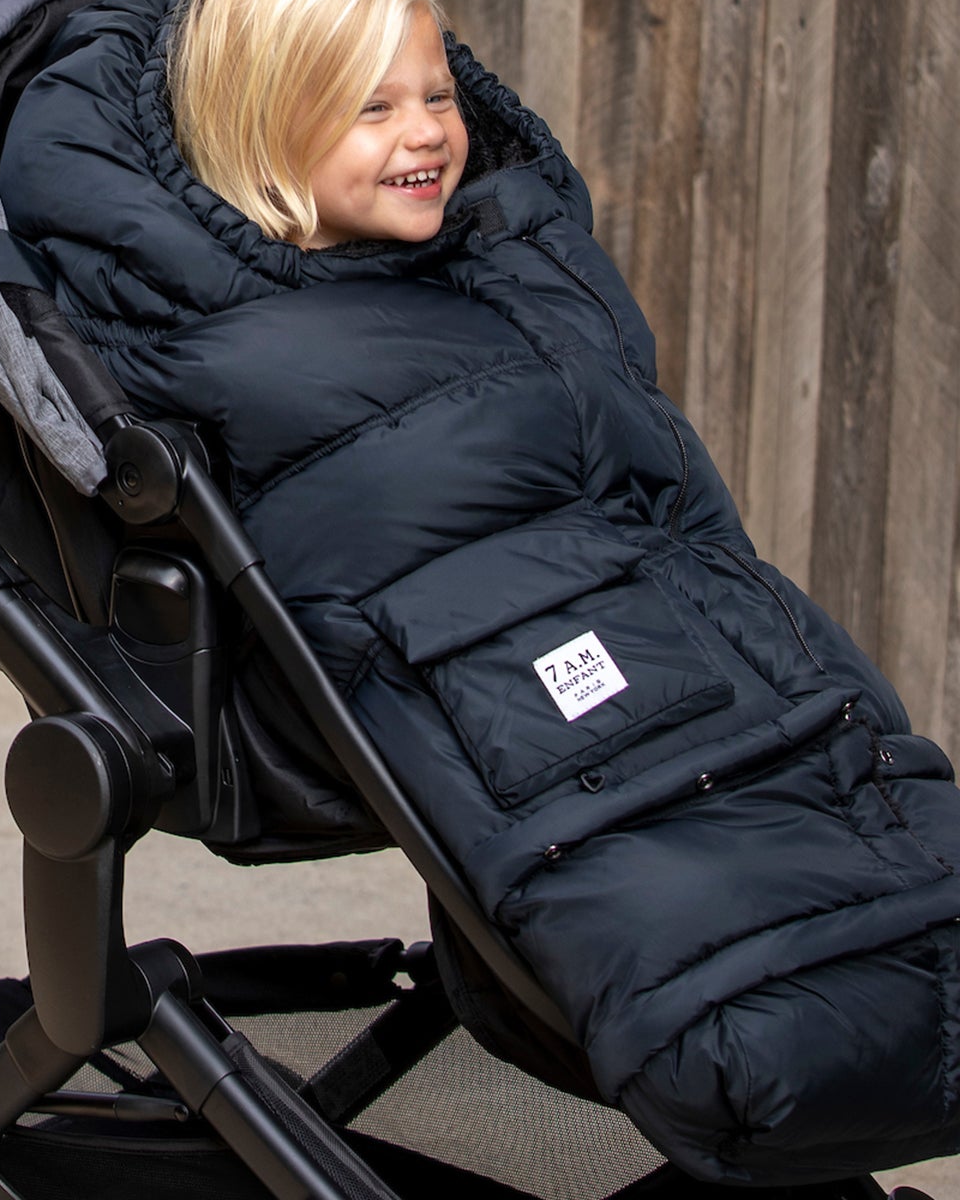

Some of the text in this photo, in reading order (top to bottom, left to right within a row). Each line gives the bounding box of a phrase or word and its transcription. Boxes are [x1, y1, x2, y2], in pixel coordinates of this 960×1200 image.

[544, 649, 600, 683] 7 A.M.
[556, 660, 605, 695] ENFANT
